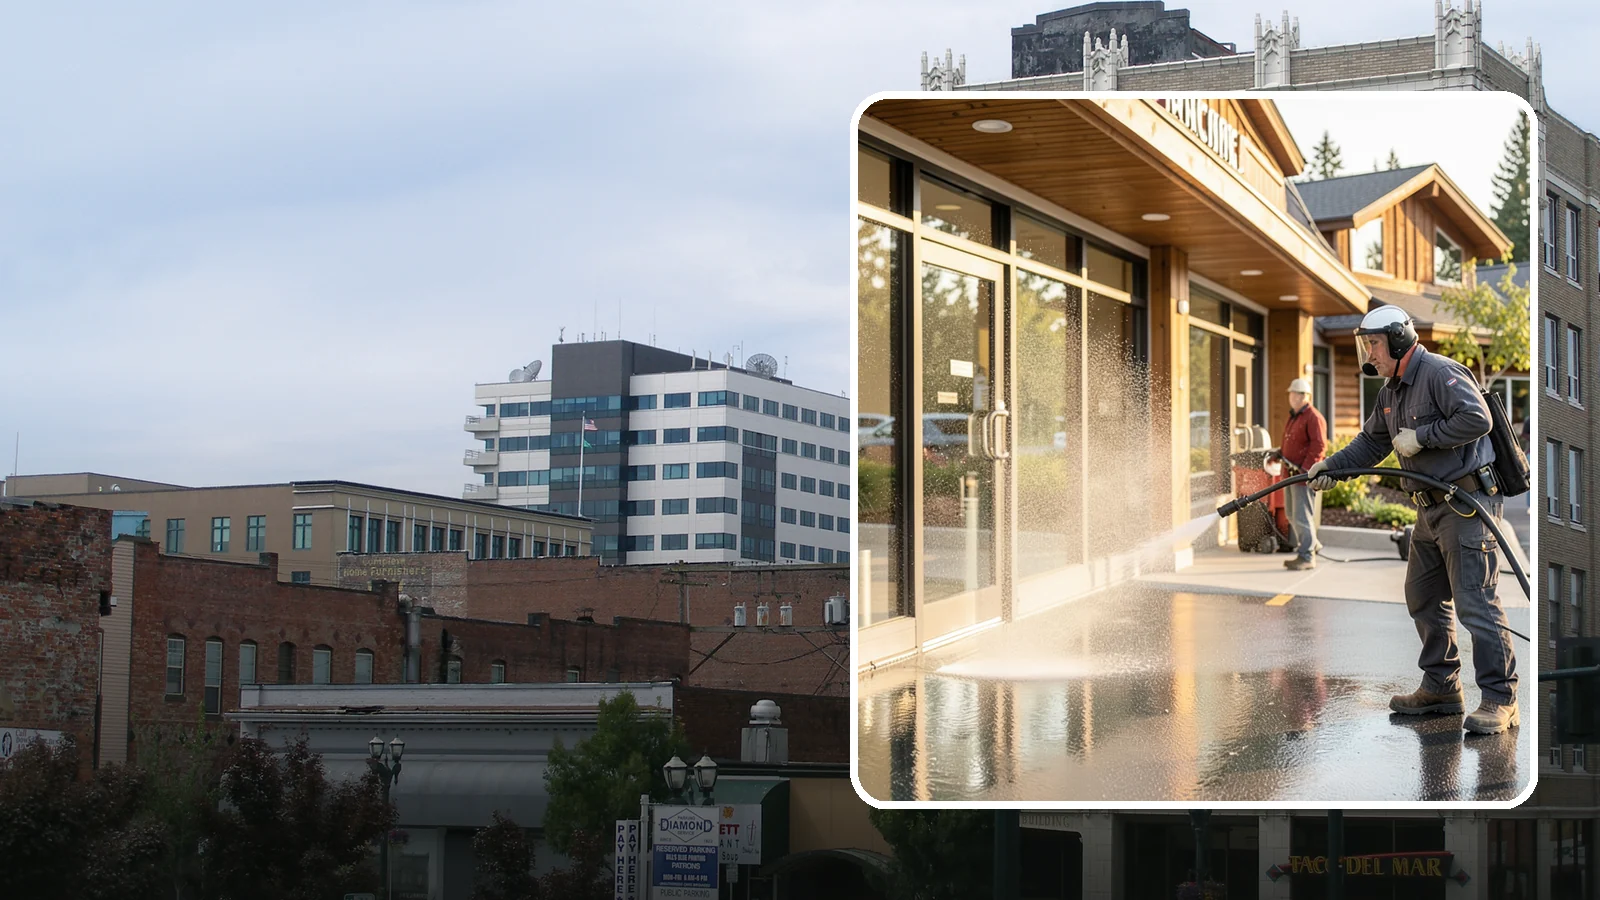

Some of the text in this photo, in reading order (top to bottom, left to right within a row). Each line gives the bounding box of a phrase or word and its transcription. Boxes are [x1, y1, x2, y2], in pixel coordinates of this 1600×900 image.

[343, 566, 427, 577] Home Furnishers
[660, 818, 713, 832] DIAMOND
[1022, 815, 1069, 827] BUILDING
[617, 825, 625, 852] PAY
[628, 825, 636, 852] PAY
[655, 845, 716, 854] RESERVED PARKING
[721, 852, 739, 862] Soup
[671, 862, 701, 870] PATRONS
[1346, 856, 1385, 875] DEL
[1392, 857, 1442, 876] MAR
[616, 856, 625, 893] HERE
[627, 856, 636, 893] HERE
[660, 888, 710, 898] PUBLIC PARKING
